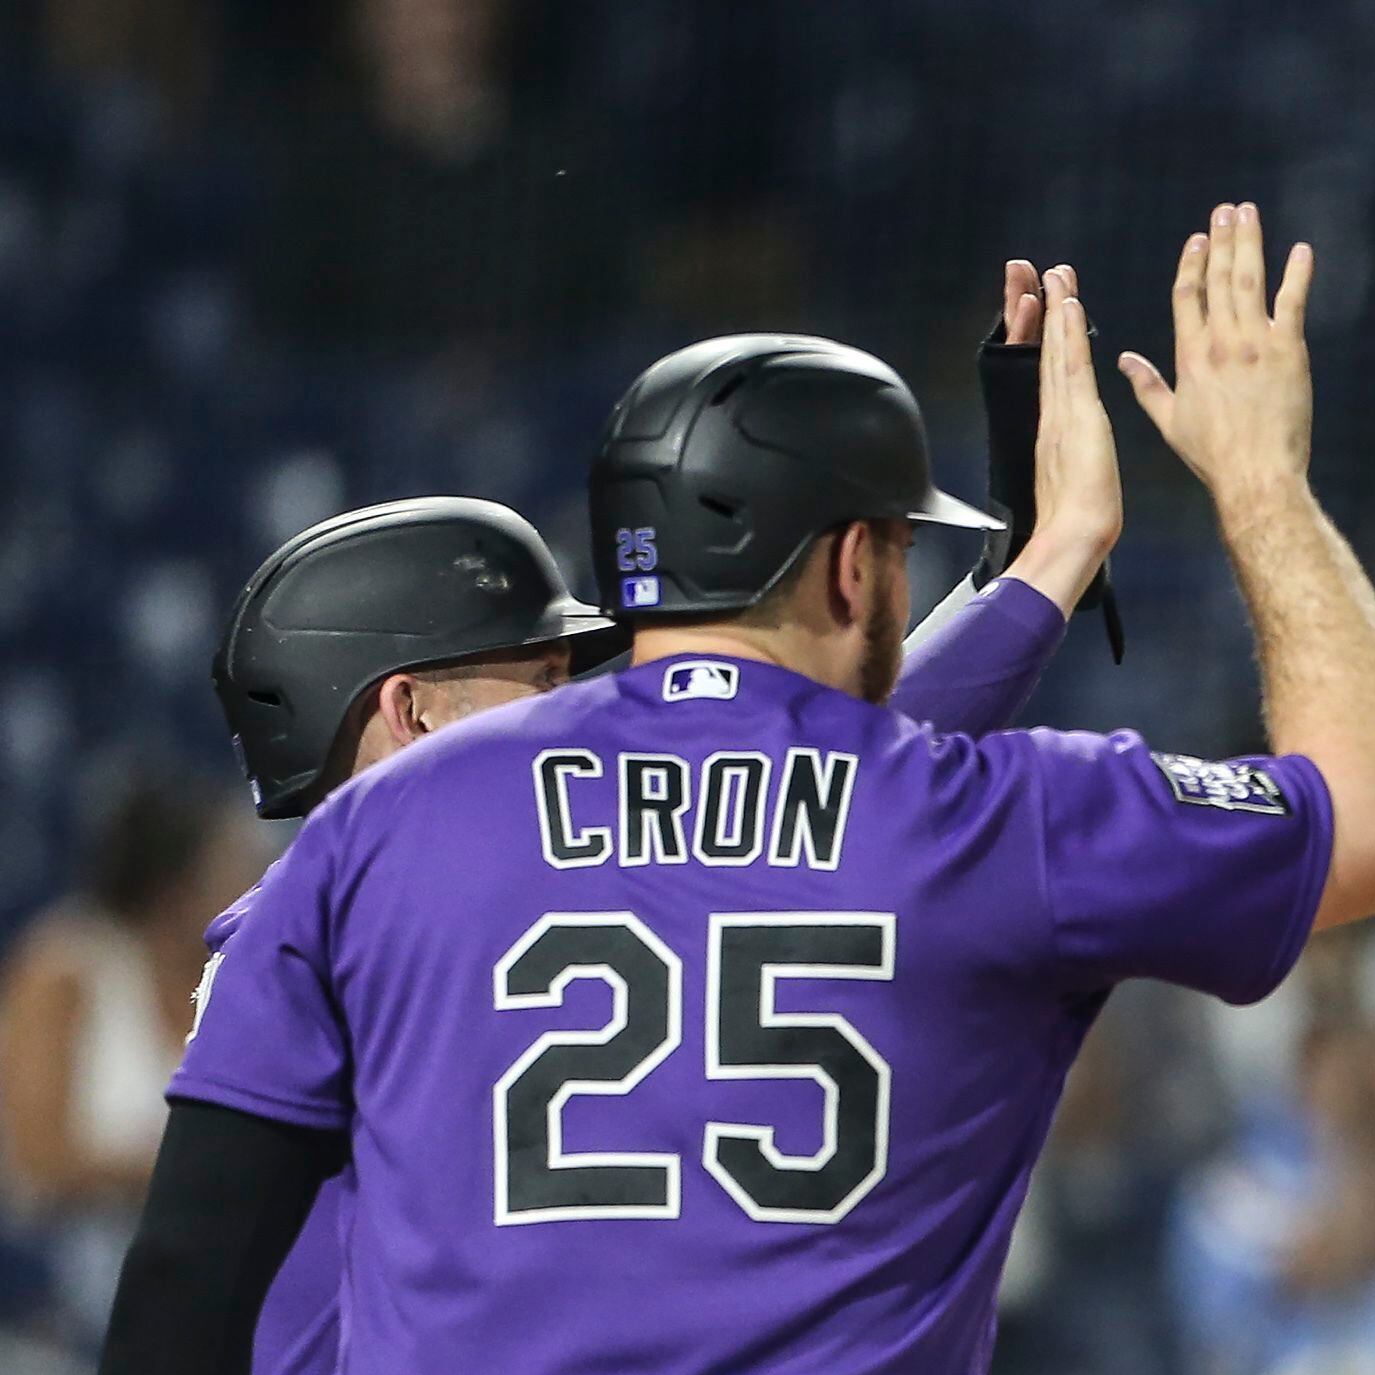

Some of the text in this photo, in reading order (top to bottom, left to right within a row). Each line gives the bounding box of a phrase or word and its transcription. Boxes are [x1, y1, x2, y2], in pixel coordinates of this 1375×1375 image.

[616, 527, 657, 571] 25
[532, 748, 858, 871] CRON
[493, 911, 897, 1226] 25
